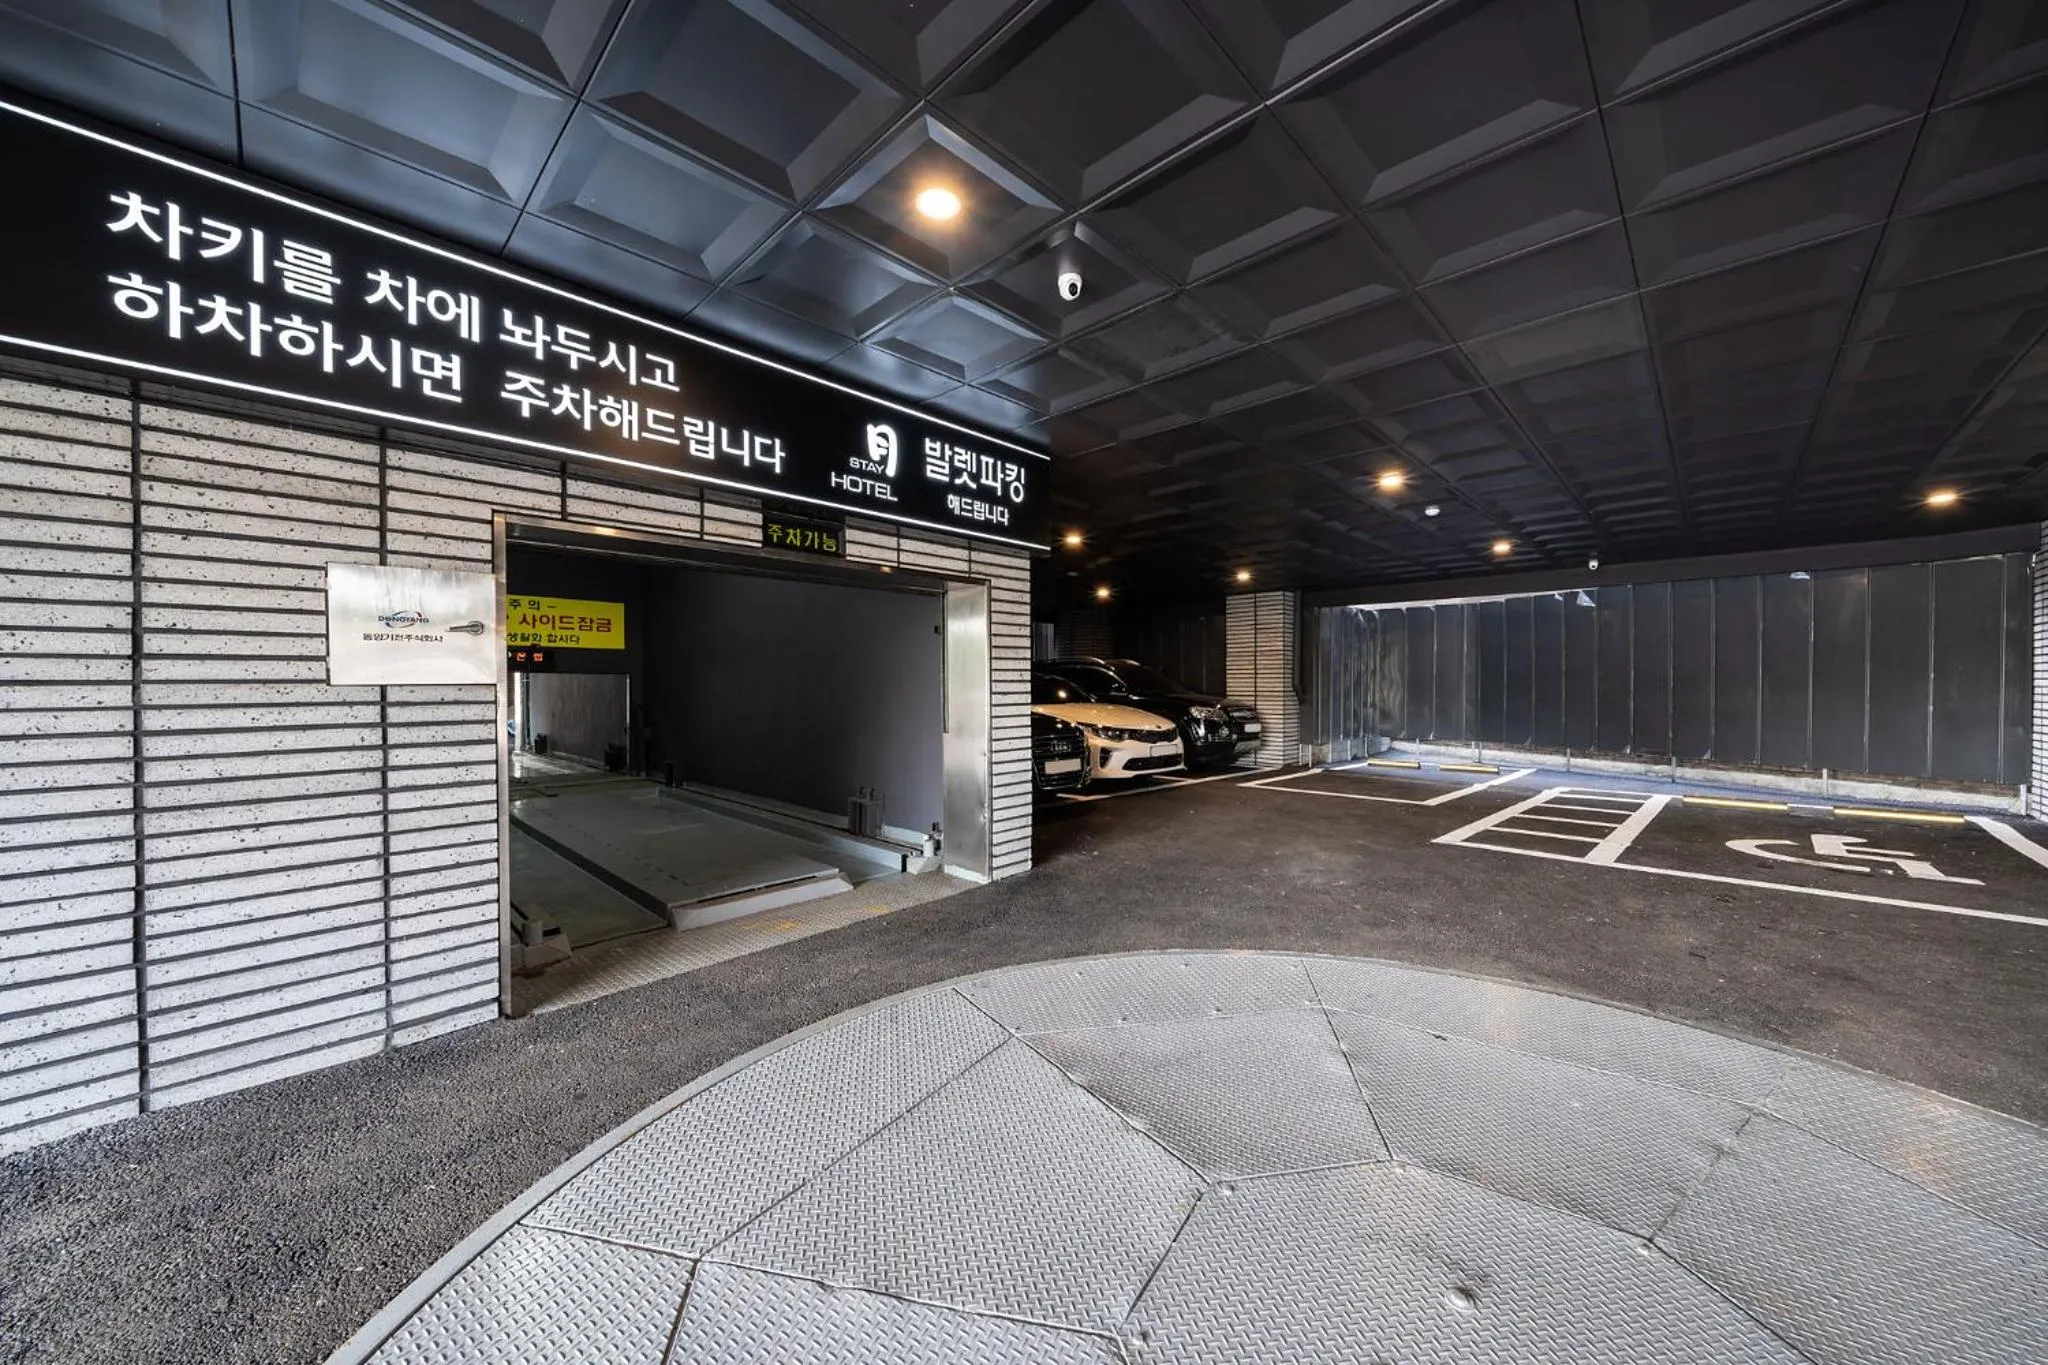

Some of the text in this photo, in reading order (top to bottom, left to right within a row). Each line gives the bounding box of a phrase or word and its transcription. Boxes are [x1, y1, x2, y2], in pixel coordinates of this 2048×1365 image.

[107, 191, 680, 392] 차키를 차에 놔두시고
[107, 272, 786, 474] 하차하시면 주차해드립니다
[831, 471, 898, 502] HOTEL
[849, 457, 884, 475] STAY
[924, 437, 1025, 503] 발렛파킹
[519, 613, 612, 633] 사이드잠금
